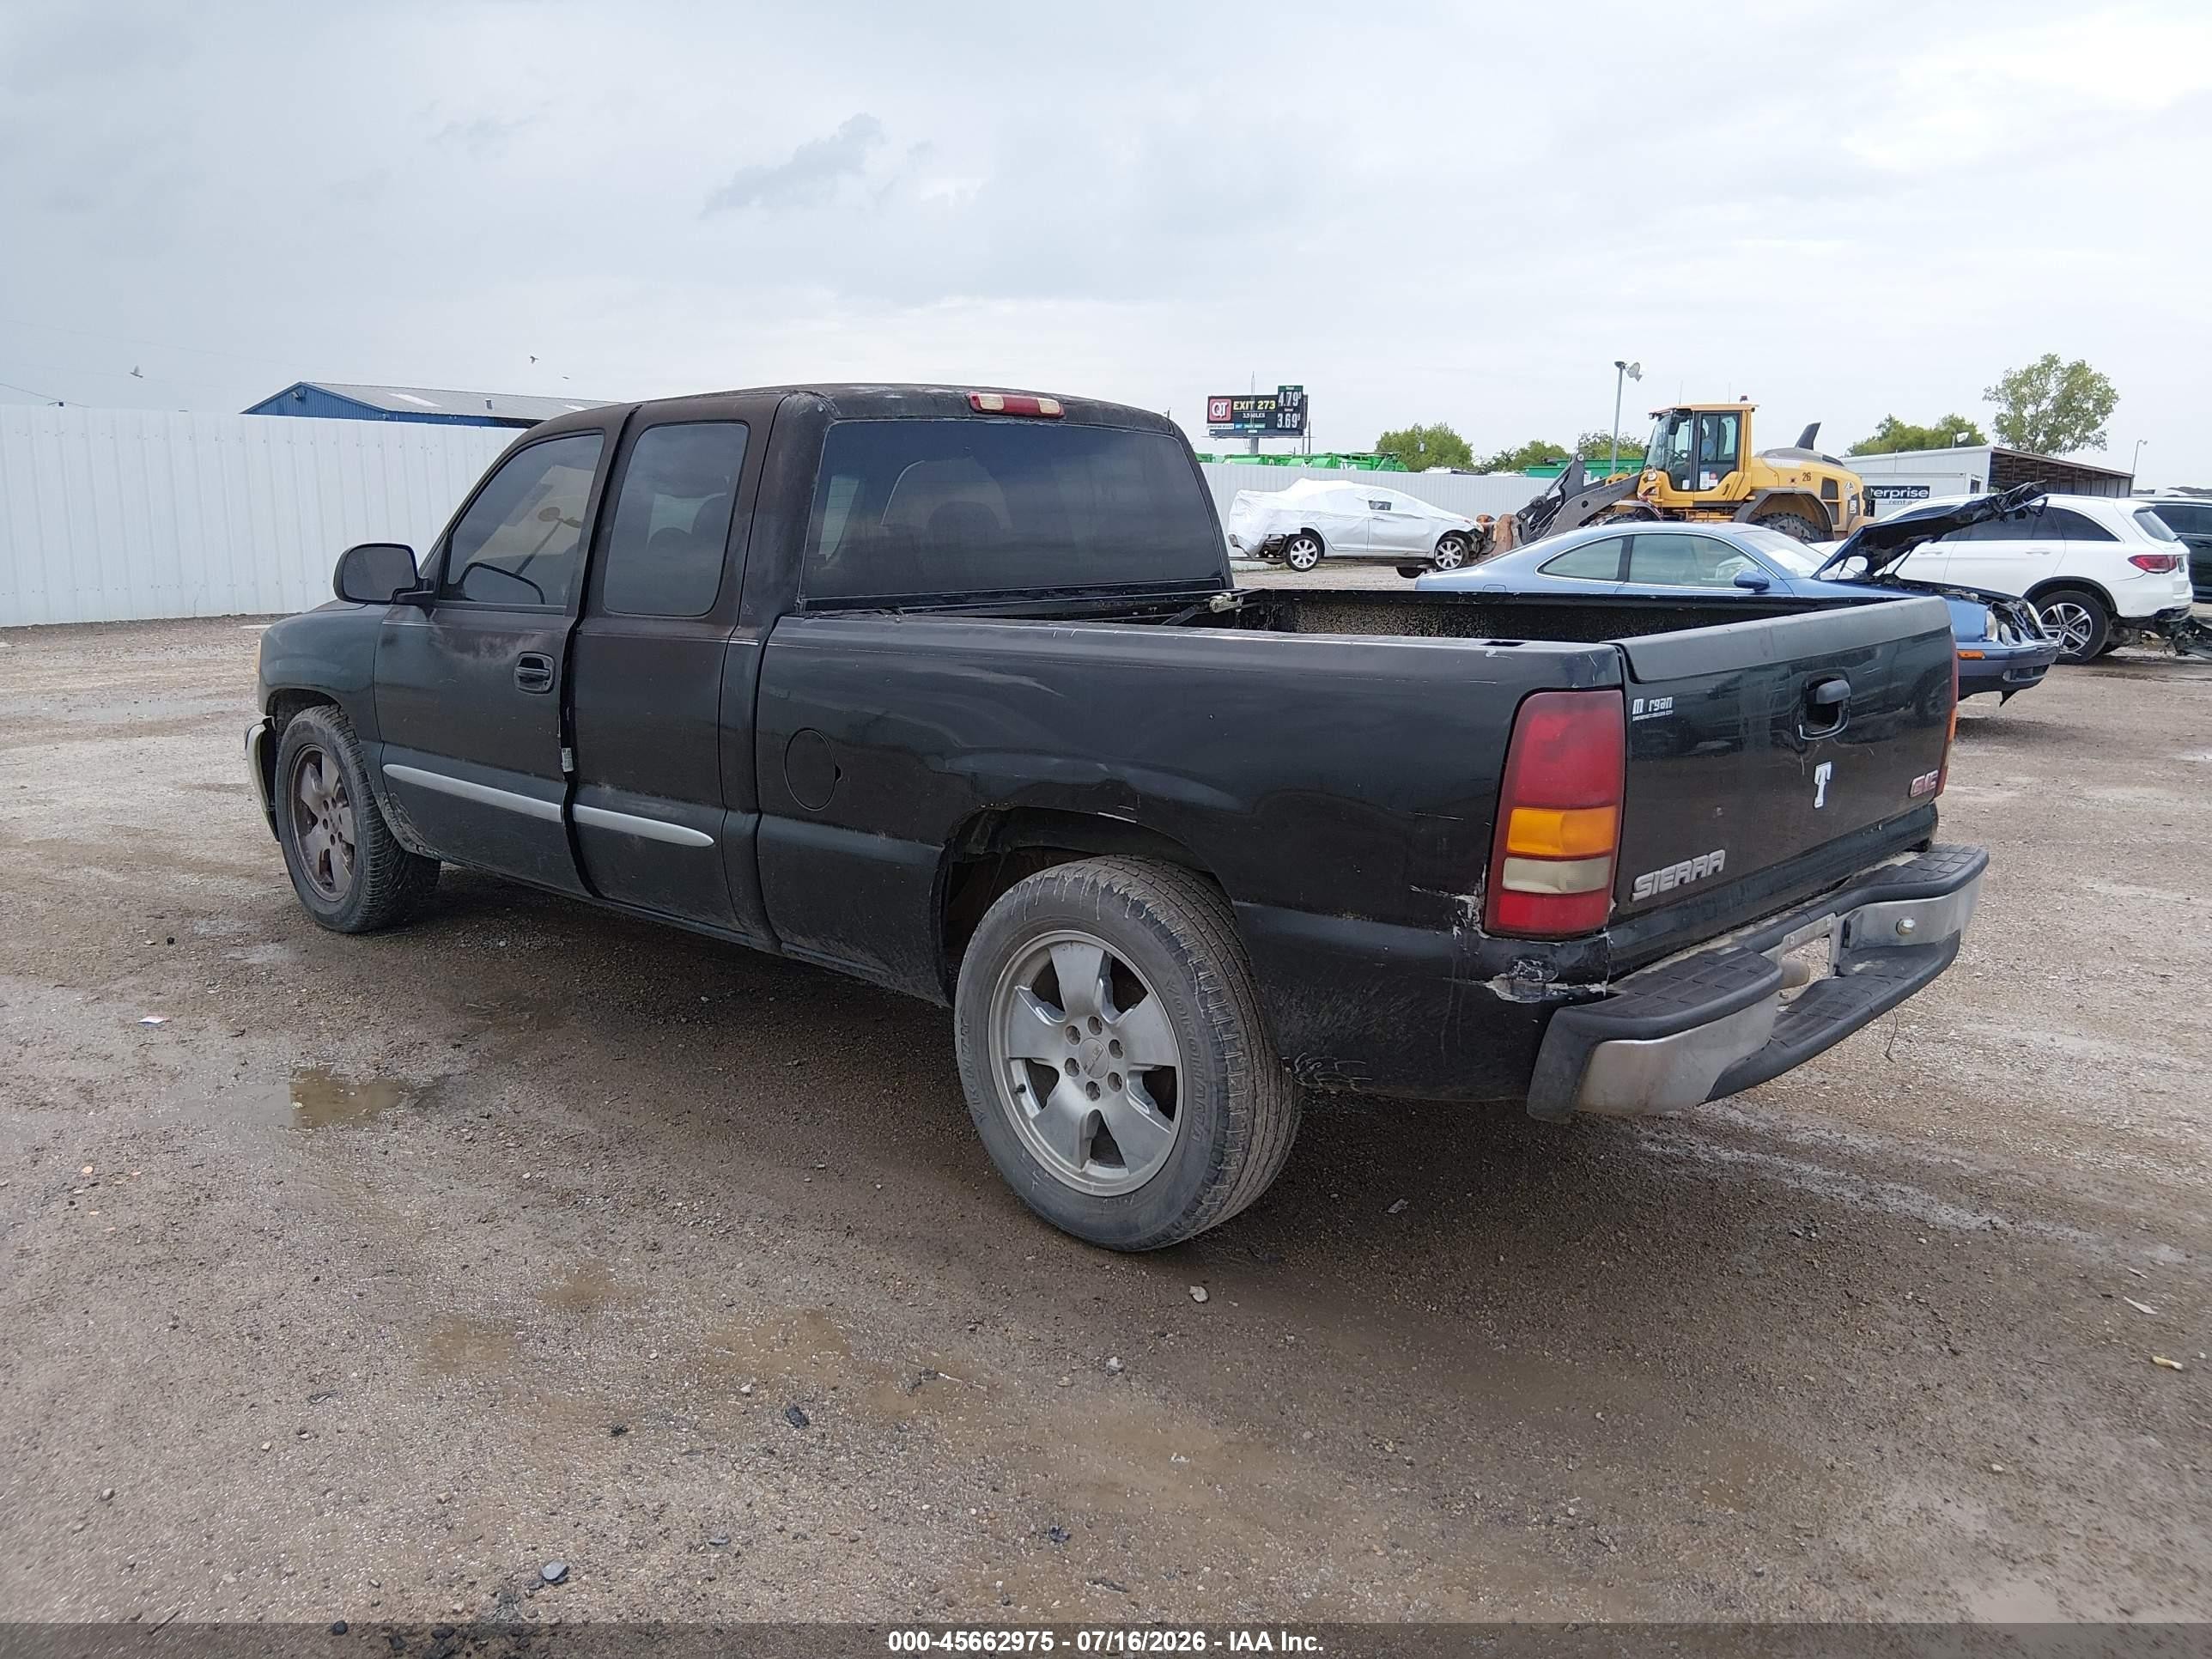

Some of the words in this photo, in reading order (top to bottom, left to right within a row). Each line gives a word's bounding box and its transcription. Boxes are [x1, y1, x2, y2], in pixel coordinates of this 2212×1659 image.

[1212, 402, 1227, 418] QT
[1233, 400, 1255, 410] EXIT
[1257, 400, 1276, 410] 273
[1802, 472, 1811, 482] 26
[1632, 849, 1725, 901] SIERRA
